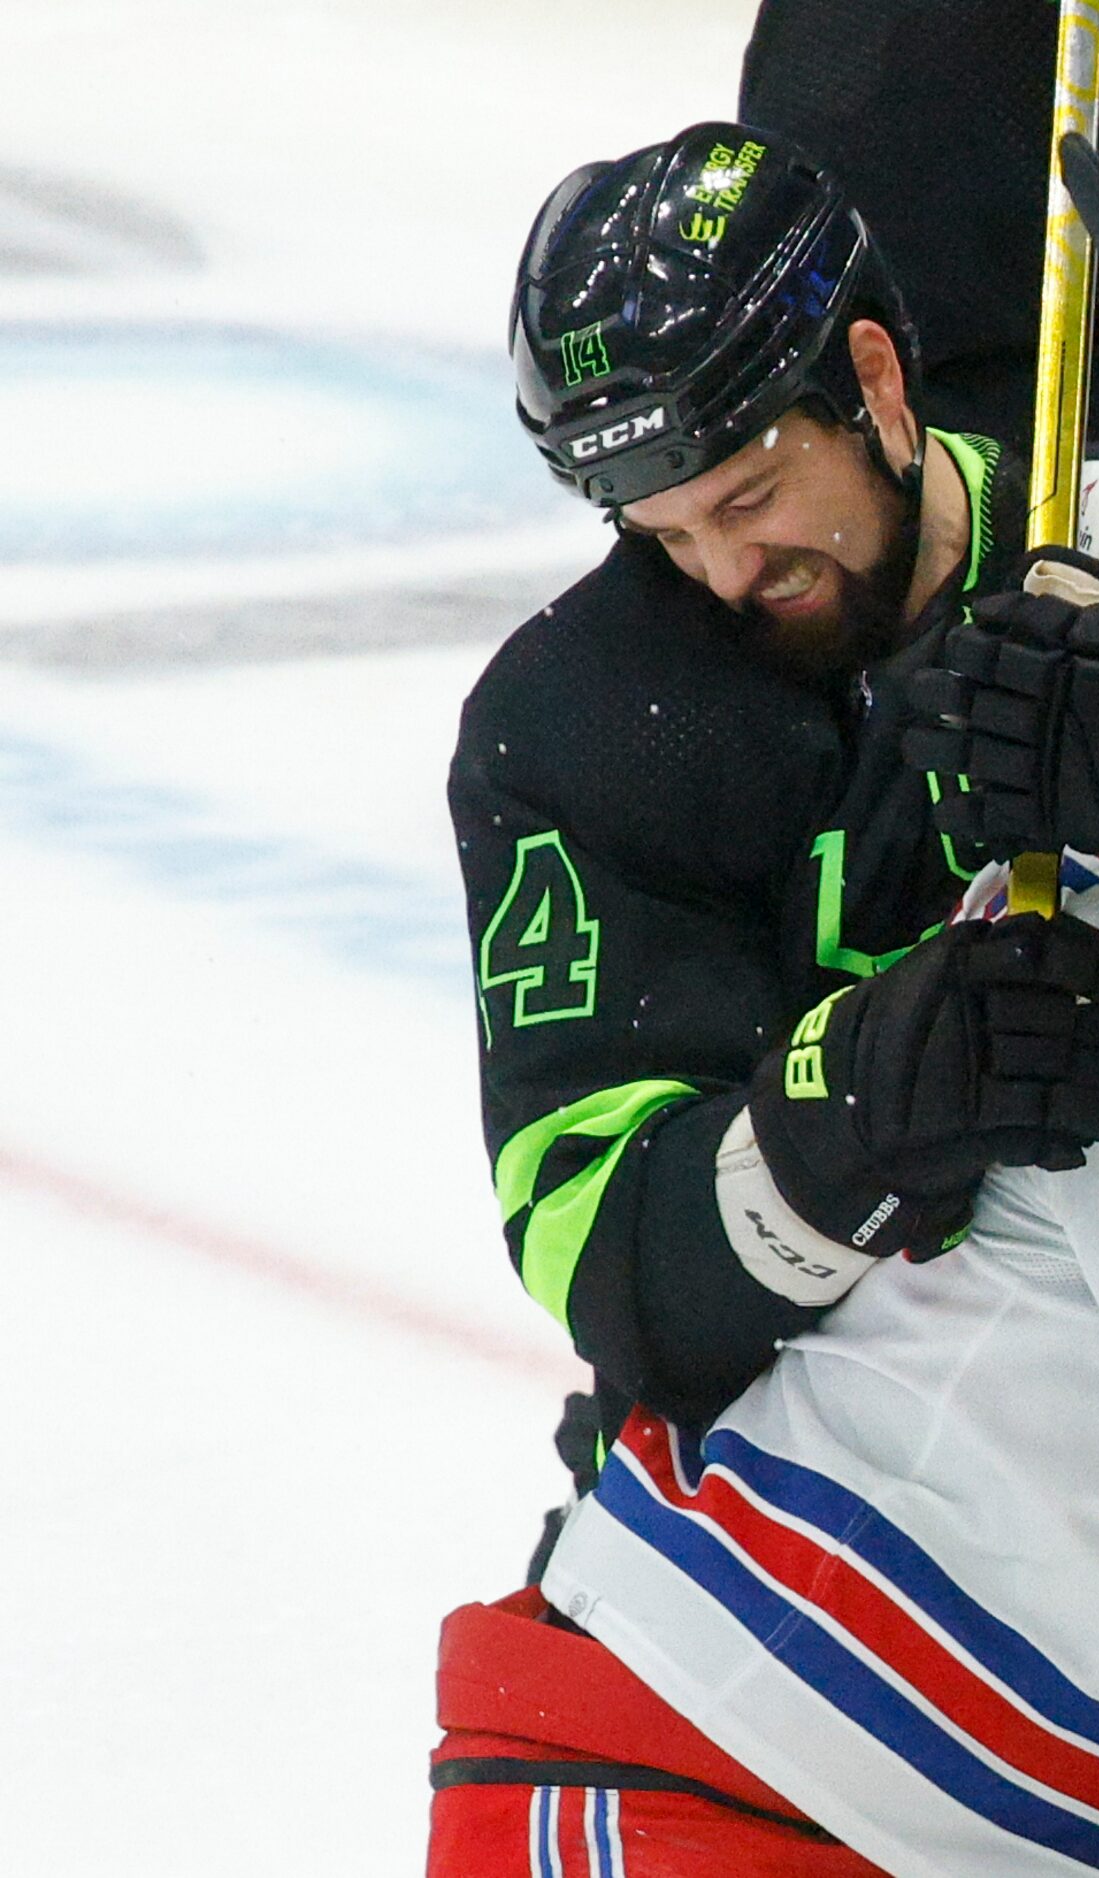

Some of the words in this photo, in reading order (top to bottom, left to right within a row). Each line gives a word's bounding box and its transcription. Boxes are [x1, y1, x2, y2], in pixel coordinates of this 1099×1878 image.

[687, 143, 735, 204] ENRGY
[560, 320, 610, 386] 14
[569, 406, 664, 458] CCM
[476, 829, 599, 1050] 4
[745, 1208, 838, 1279] CCM
[851, 1193, 901, 1247] CHUBBS
